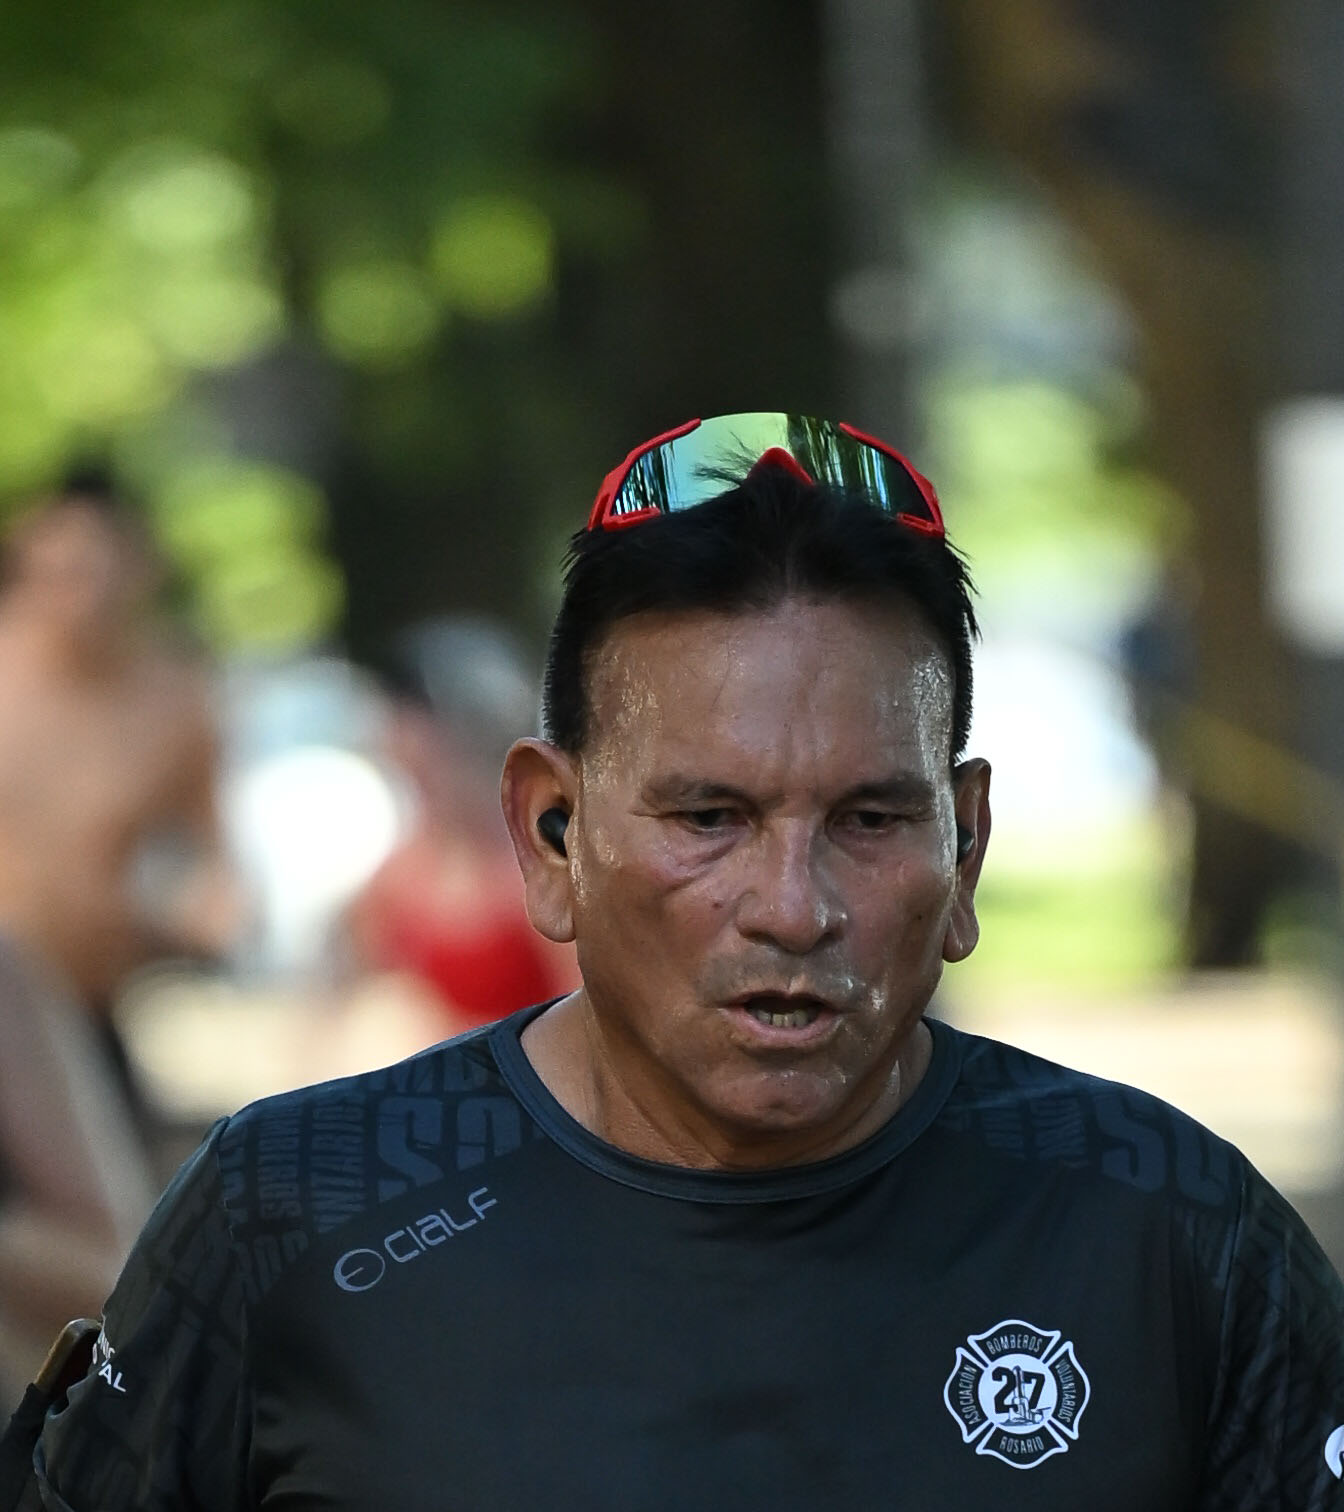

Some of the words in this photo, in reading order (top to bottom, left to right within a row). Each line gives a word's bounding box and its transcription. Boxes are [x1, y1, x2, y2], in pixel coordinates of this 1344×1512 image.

[985, 1334, 1044, 1355] BOMBEROS
[991, 1366, 1046, 1414] 27
[1054, 1358, 1077, 1424] VOLUNTARIOS
[999, 1435, 1045, 1454] ROSARIO
